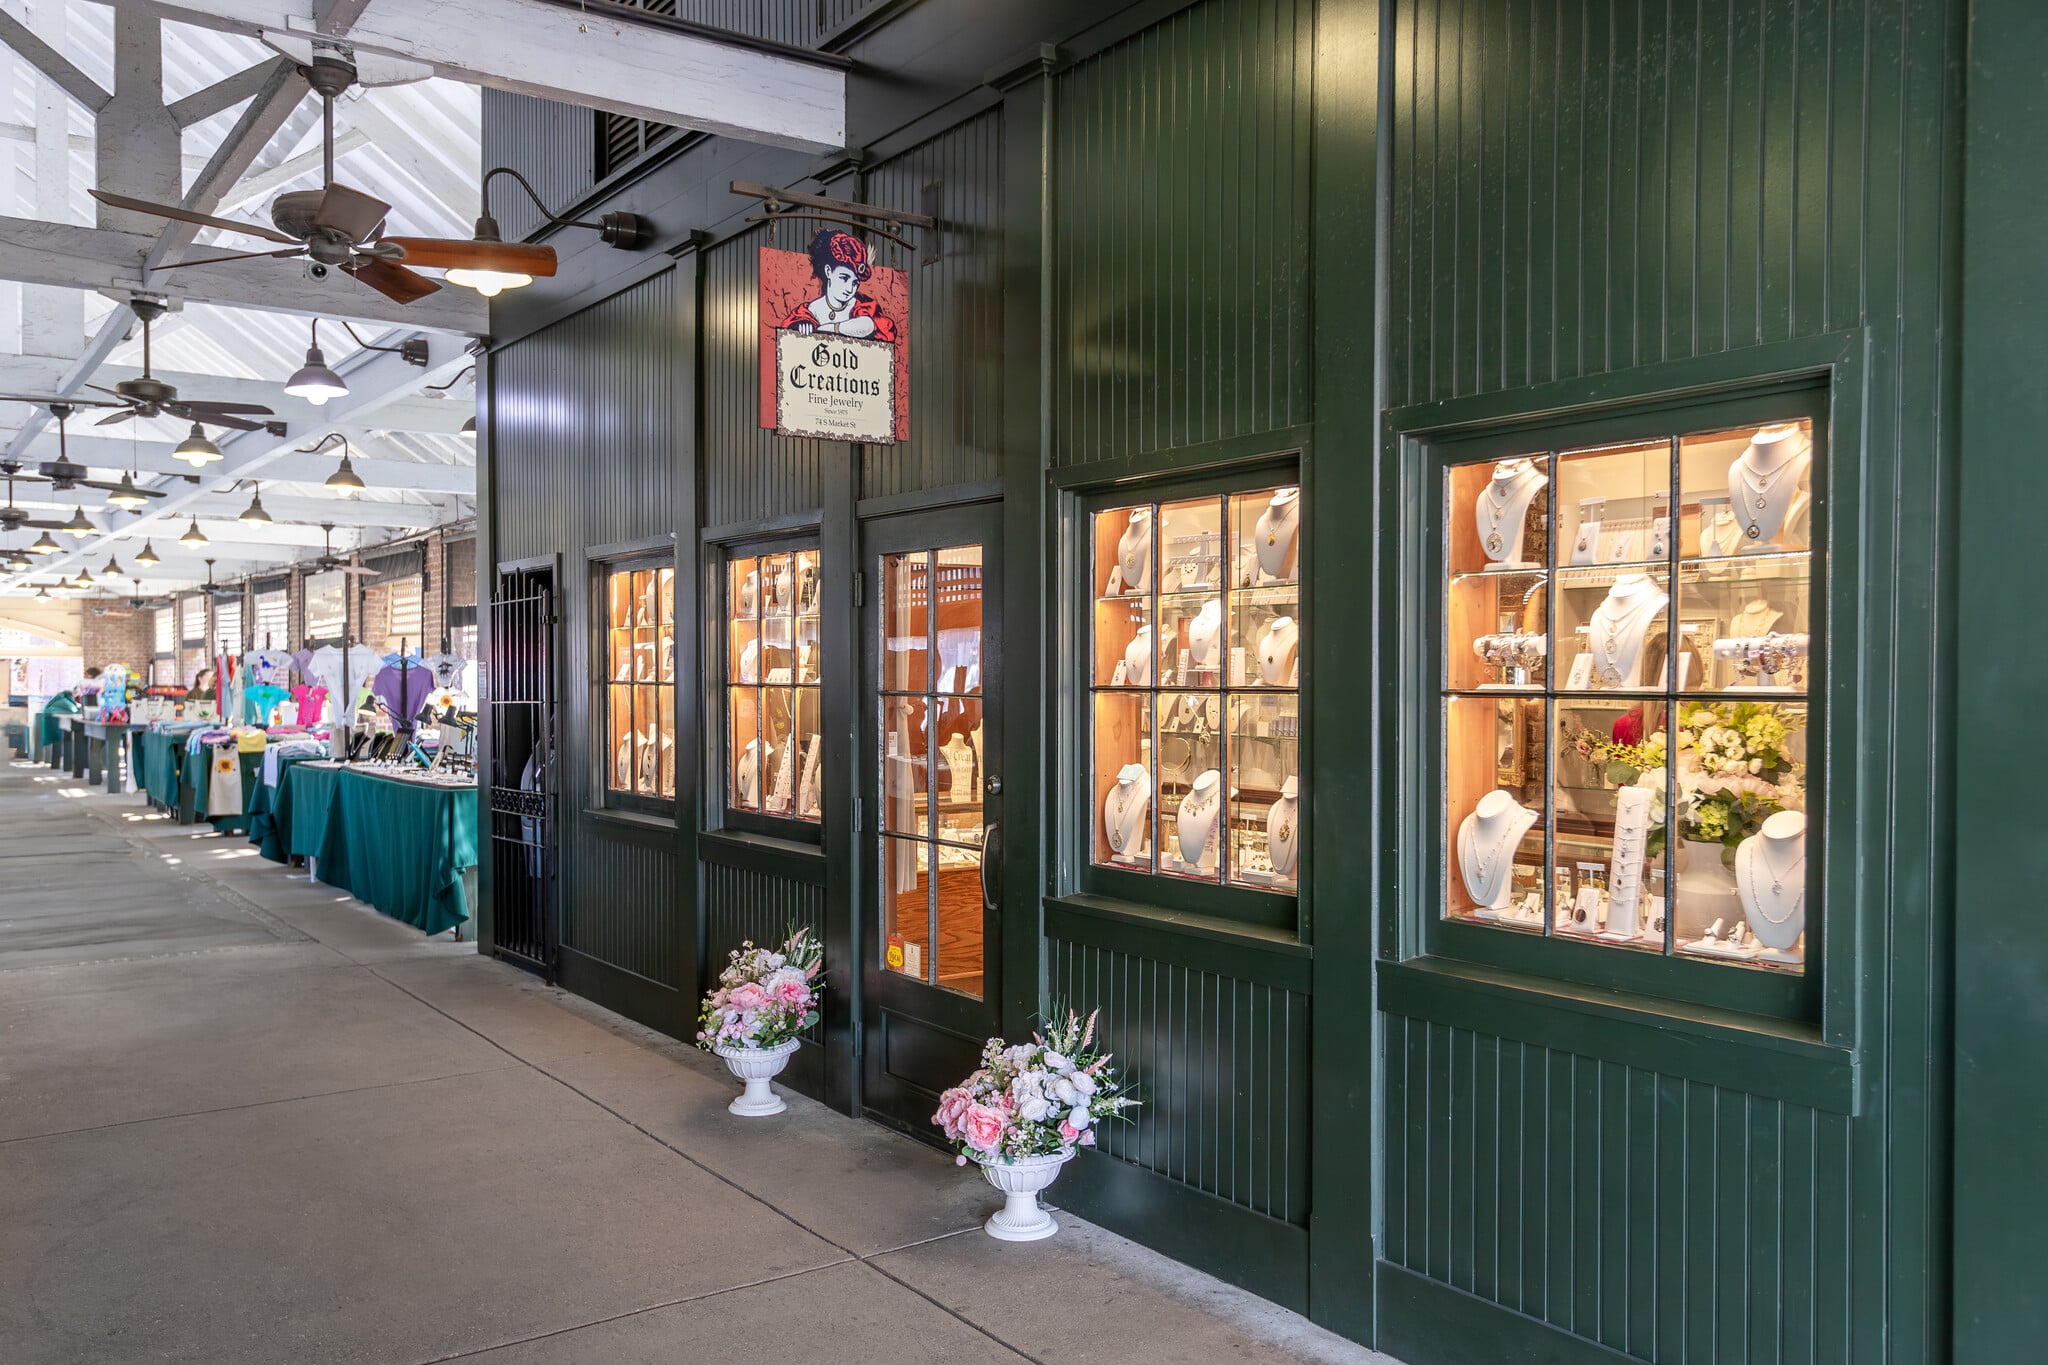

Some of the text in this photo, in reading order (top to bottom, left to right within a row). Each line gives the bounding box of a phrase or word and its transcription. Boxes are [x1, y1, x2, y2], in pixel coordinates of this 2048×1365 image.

[811, 343, 858, 370] Gold
[790, 364, 880, 396] Creations
[808, 393, 864, 411] Fine Jewelry
[828, 419, 850, 428] Market
[850, 421, 857, 429] St
